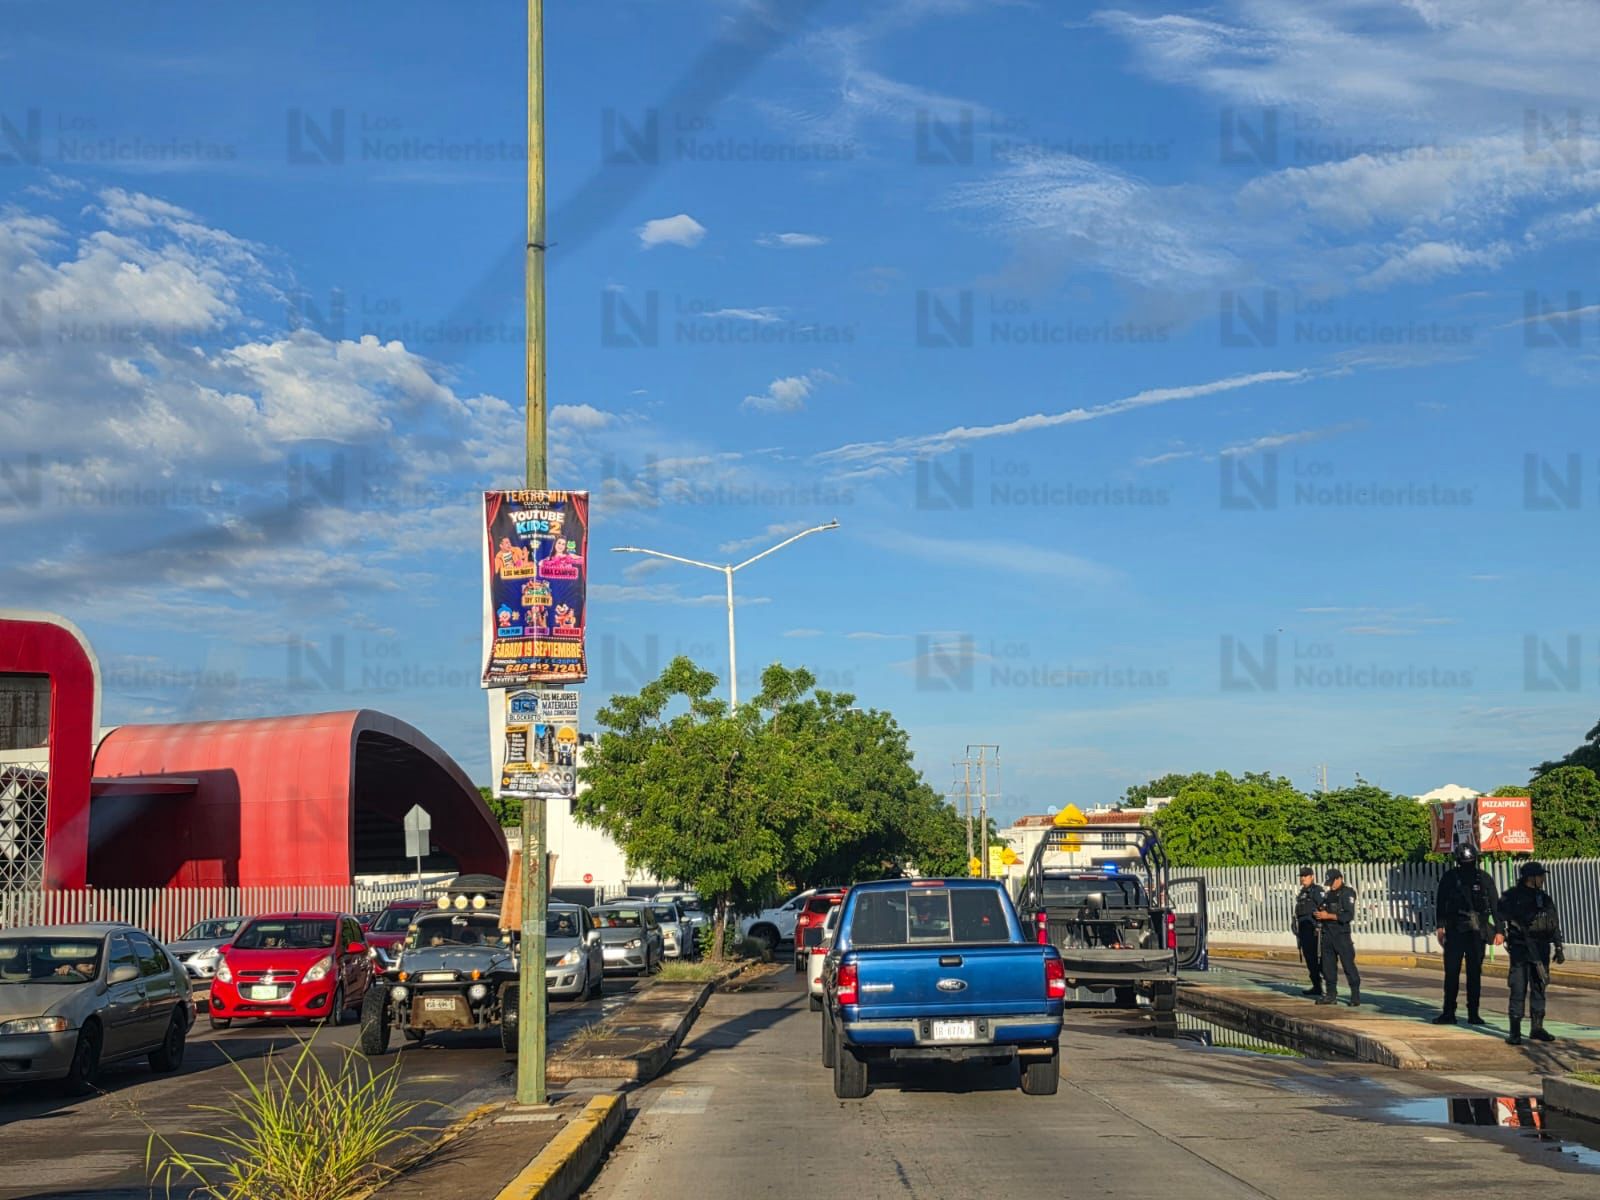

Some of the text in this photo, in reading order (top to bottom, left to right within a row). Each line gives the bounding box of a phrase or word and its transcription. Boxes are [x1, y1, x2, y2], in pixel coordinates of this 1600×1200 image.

[508, 509, 566, 523] YOUTUBE
[516, 520, 561, 534] KIDS 2
[534, 641, 582, 658] SEPTIEMBRE
[551, 692, 577, 701] MEJORES
[541, 701, 578, 710] MATERIALES
[1482, 800, 1528, 808] PIZZA!PIZZA!
[1507, 829, 1527, 837] Little
